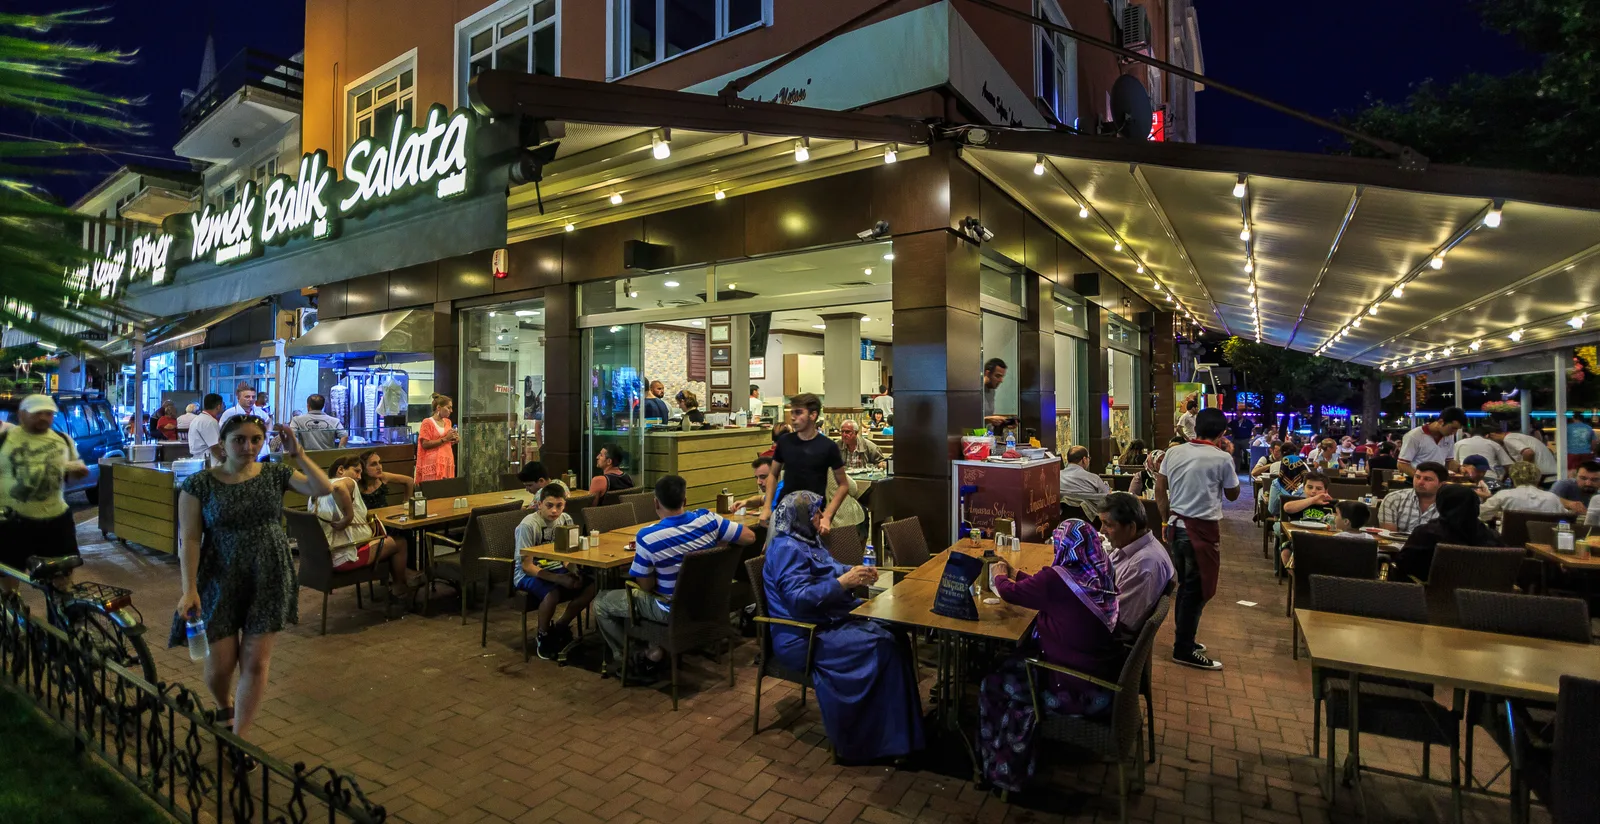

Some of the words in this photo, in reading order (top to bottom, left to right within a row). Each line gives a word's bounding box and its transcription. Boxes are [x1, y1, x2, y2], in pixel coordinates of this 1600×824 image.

[130, 232, 174, 281] Döner
[191, 181, 256, 261] Yemek
[340, 108, 469, 212] Salata
